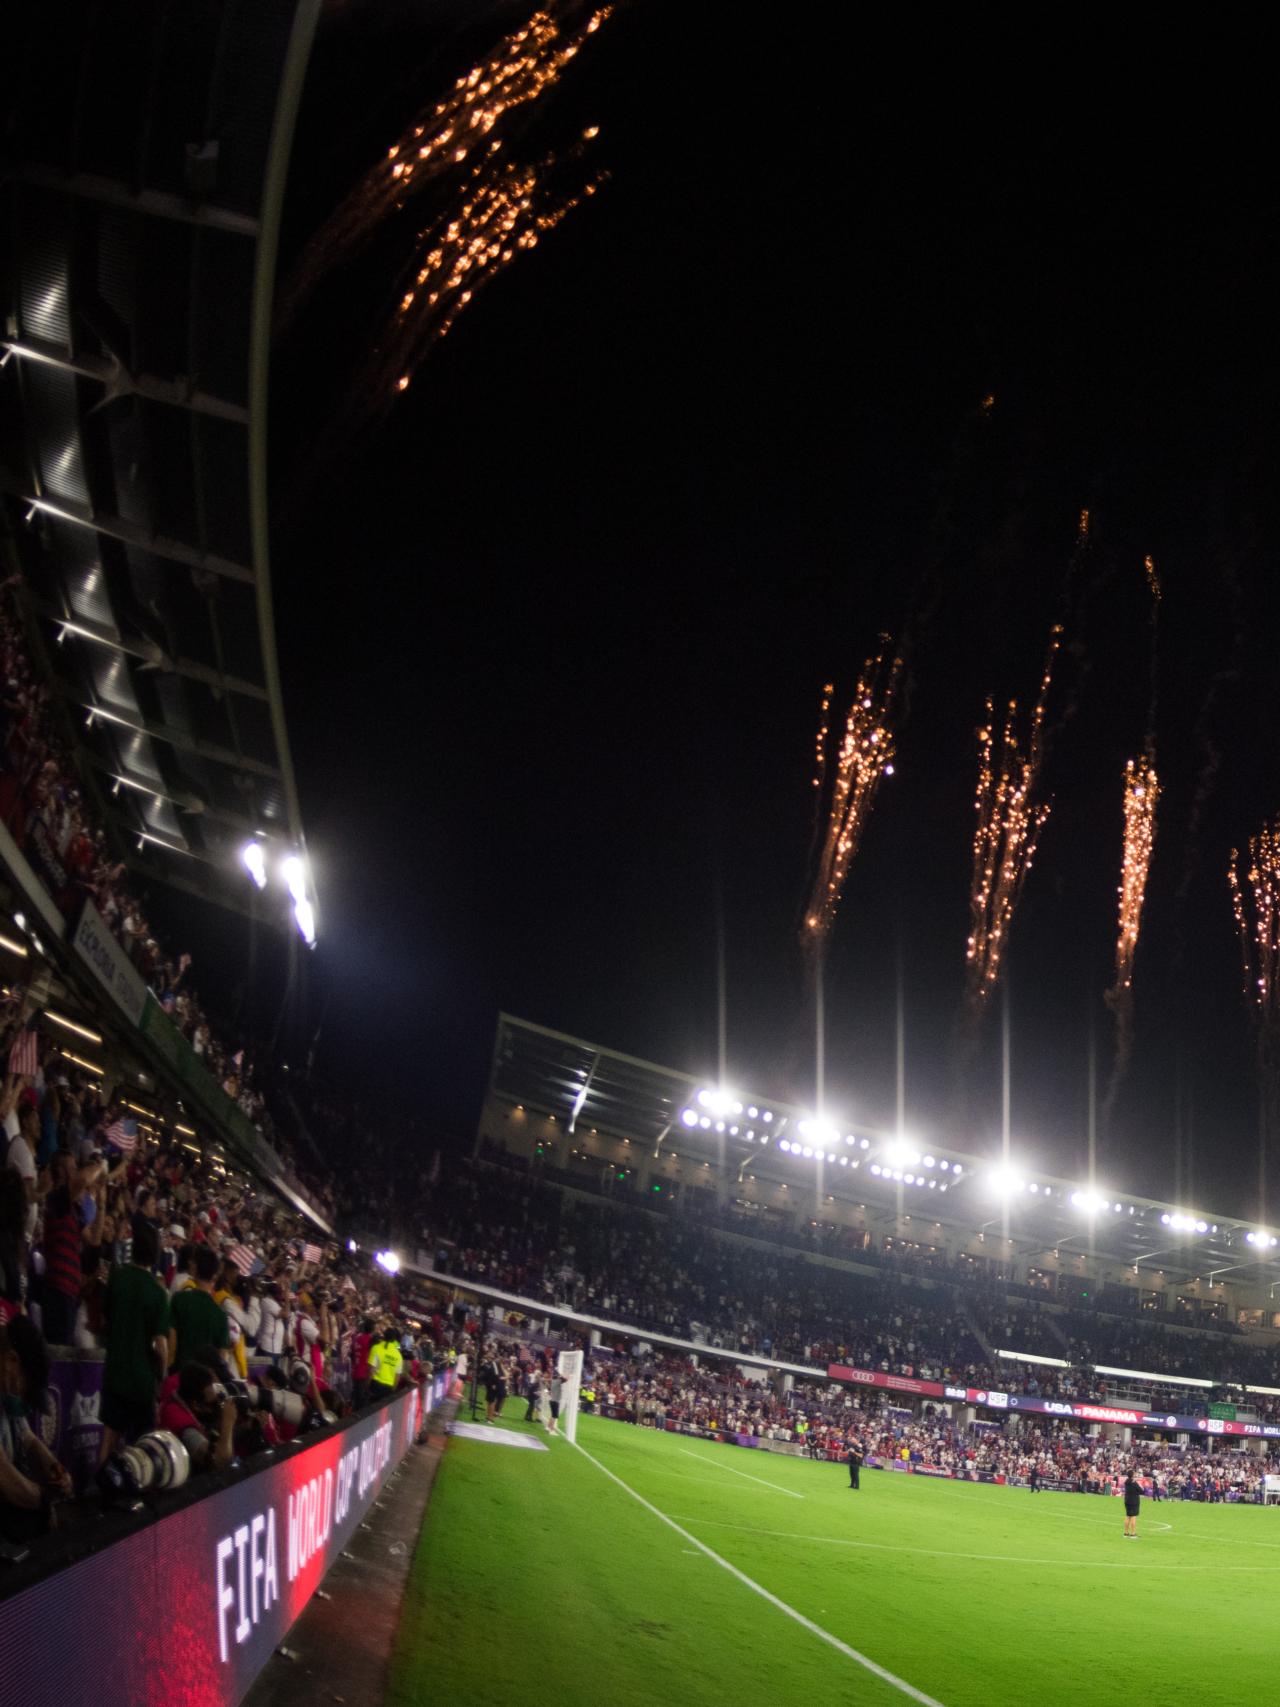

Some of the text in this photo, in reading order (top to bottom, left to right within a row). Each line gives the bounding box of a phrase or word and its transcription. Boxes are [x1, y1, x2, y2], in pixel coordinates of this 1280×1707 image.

[1044, 1402, 1073, 1415] USA
[1082, 1407, 1138, 1423] PANAMA
[1244, 1424, 1261, 1433] FIFA
[217, 1507, 279, 1663] FIFA
[288, 1467, 334, 1582] WORLD
